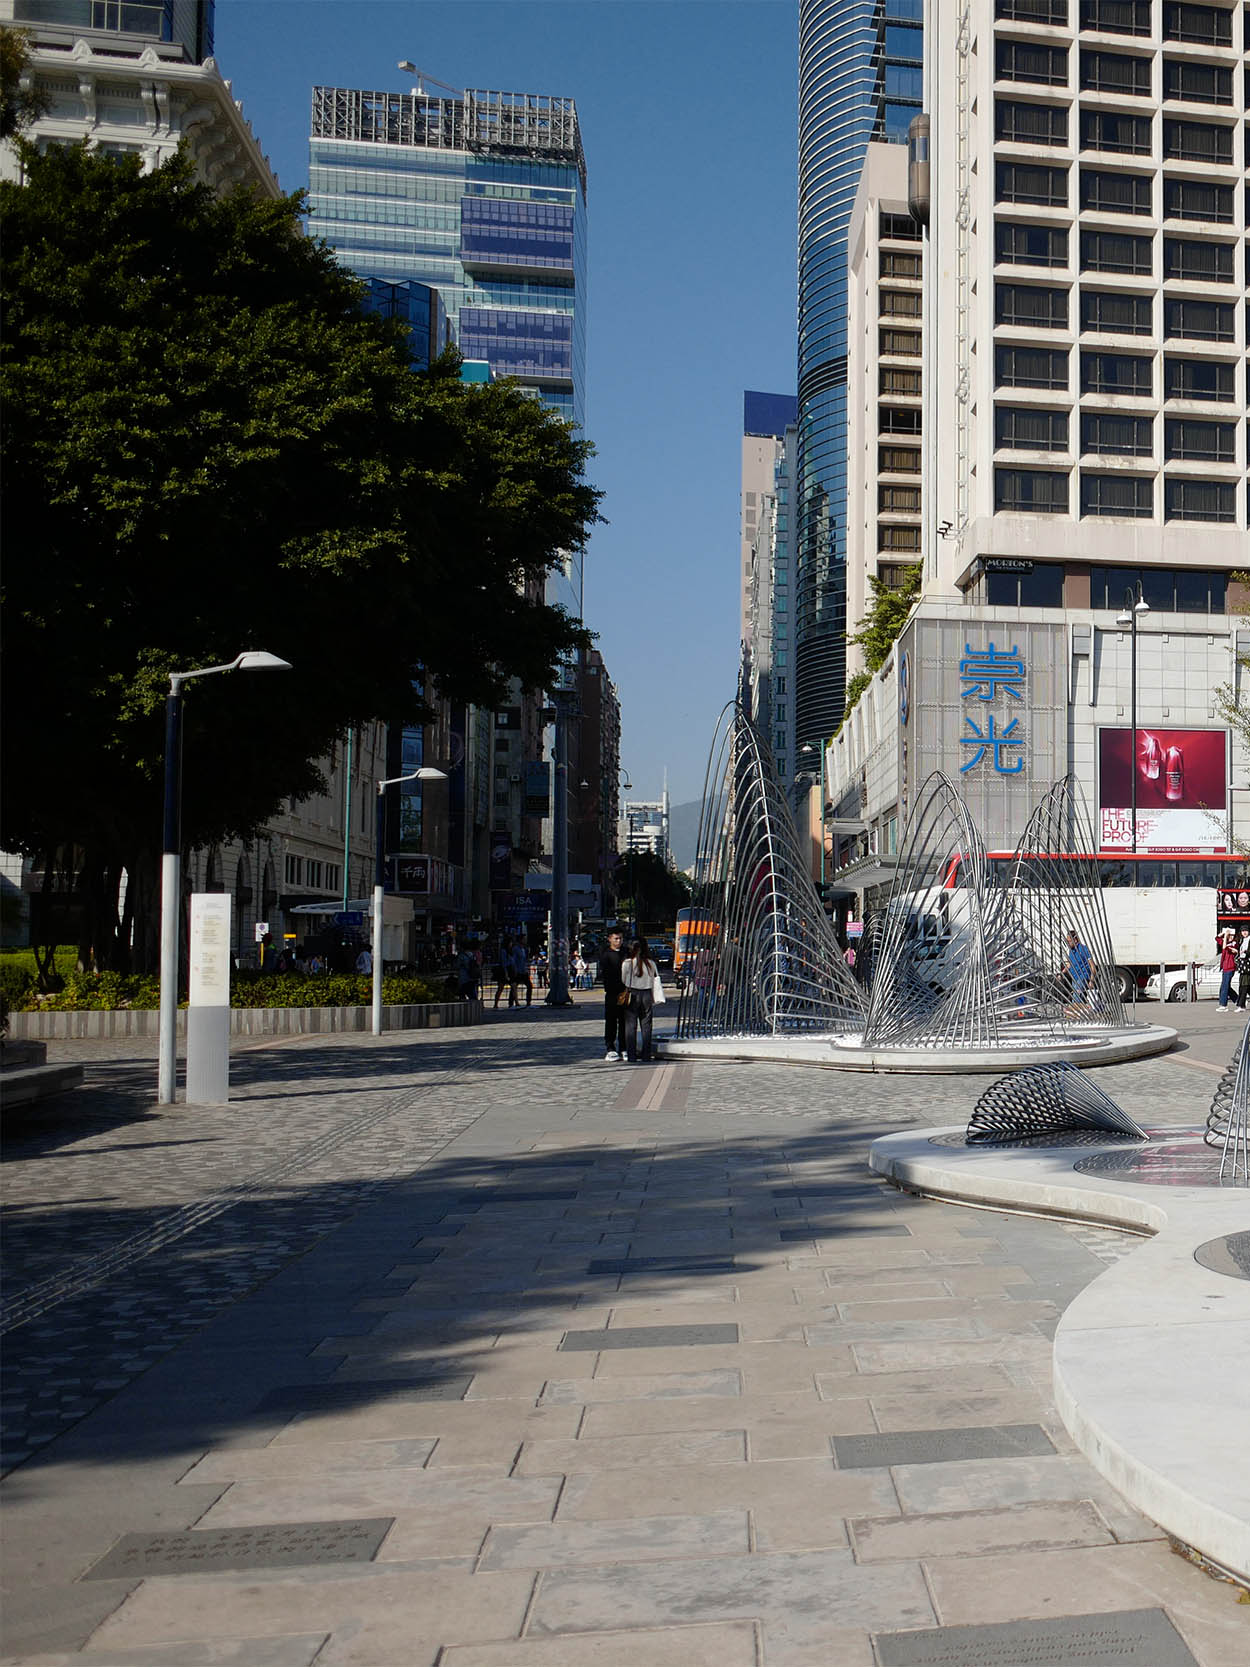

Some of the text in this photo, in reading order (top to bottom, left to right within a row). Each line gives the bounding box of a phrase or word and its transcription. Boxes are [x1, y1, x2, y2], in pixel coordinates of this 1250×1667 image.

[987, 559, 1033, 568] MORTON'S
[960, 642, 1024, 774] 崇光
[1101, 808, 1125, 820] THE
[1103, 820, 1156, 832] FUTURE
[1103, 831, 1148, 842] PROOF
[516, 896, 532, 904] ISA
